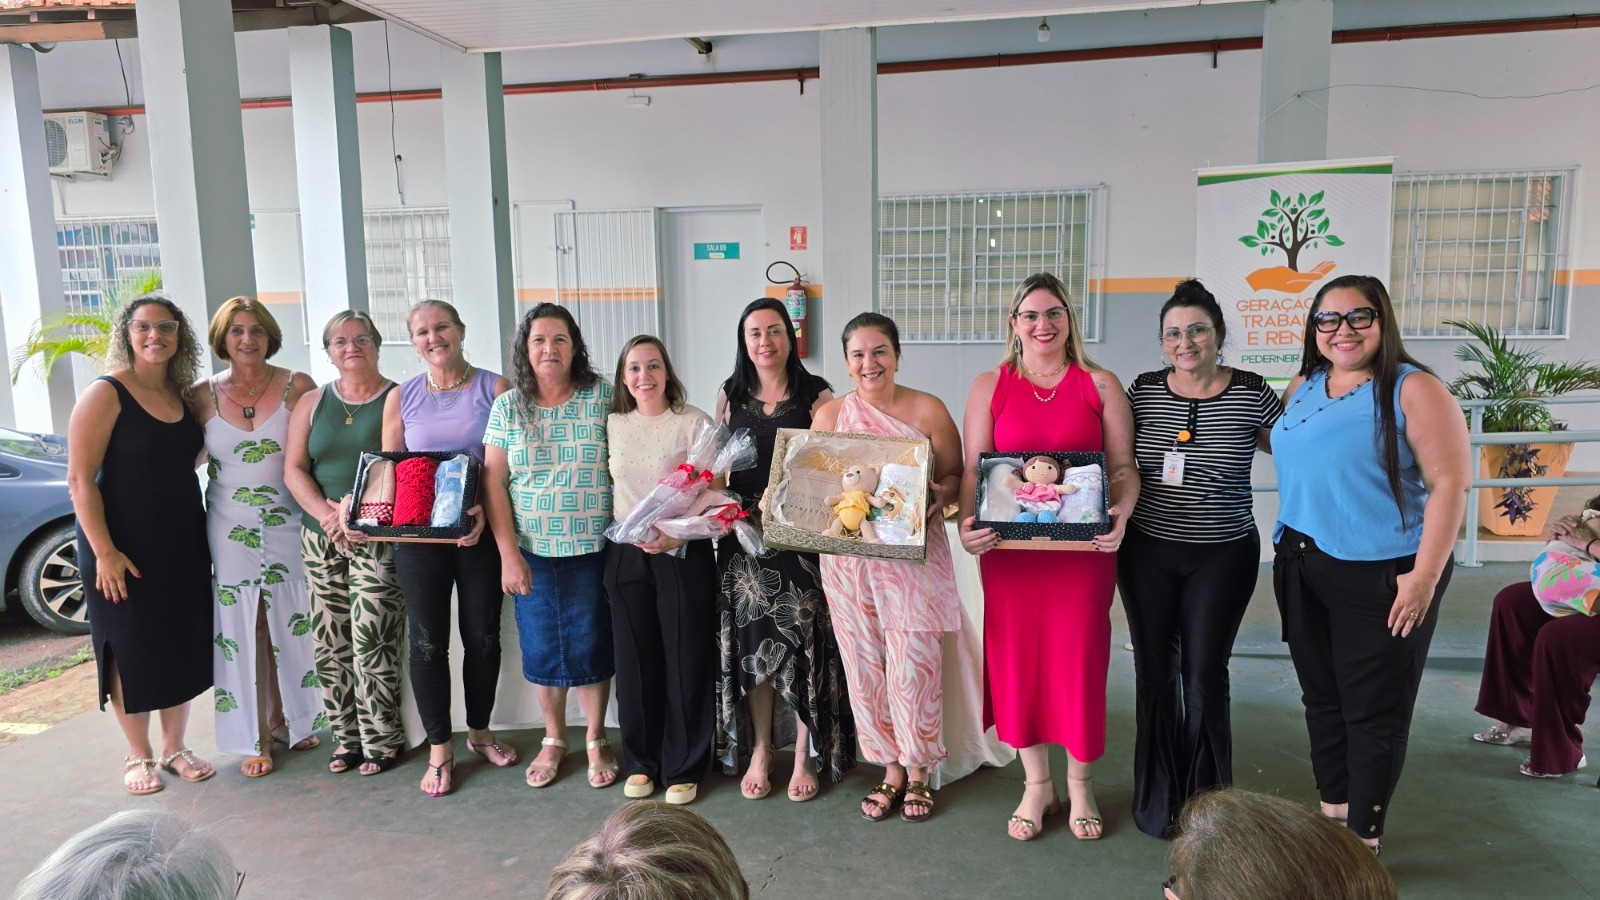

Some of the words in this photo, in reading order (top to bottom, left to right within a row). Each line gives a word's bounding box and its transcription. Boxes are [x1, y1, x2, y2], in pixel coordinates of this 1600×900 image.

[706, 244, 719, 252] SALA
[1241, 313, 1307, 328] TRABAL
[1247, 331, 1259, 346] E
[1265, 330, 1305, 345] REN
[1241, 354, 1302, 364] PEDERNEIR
